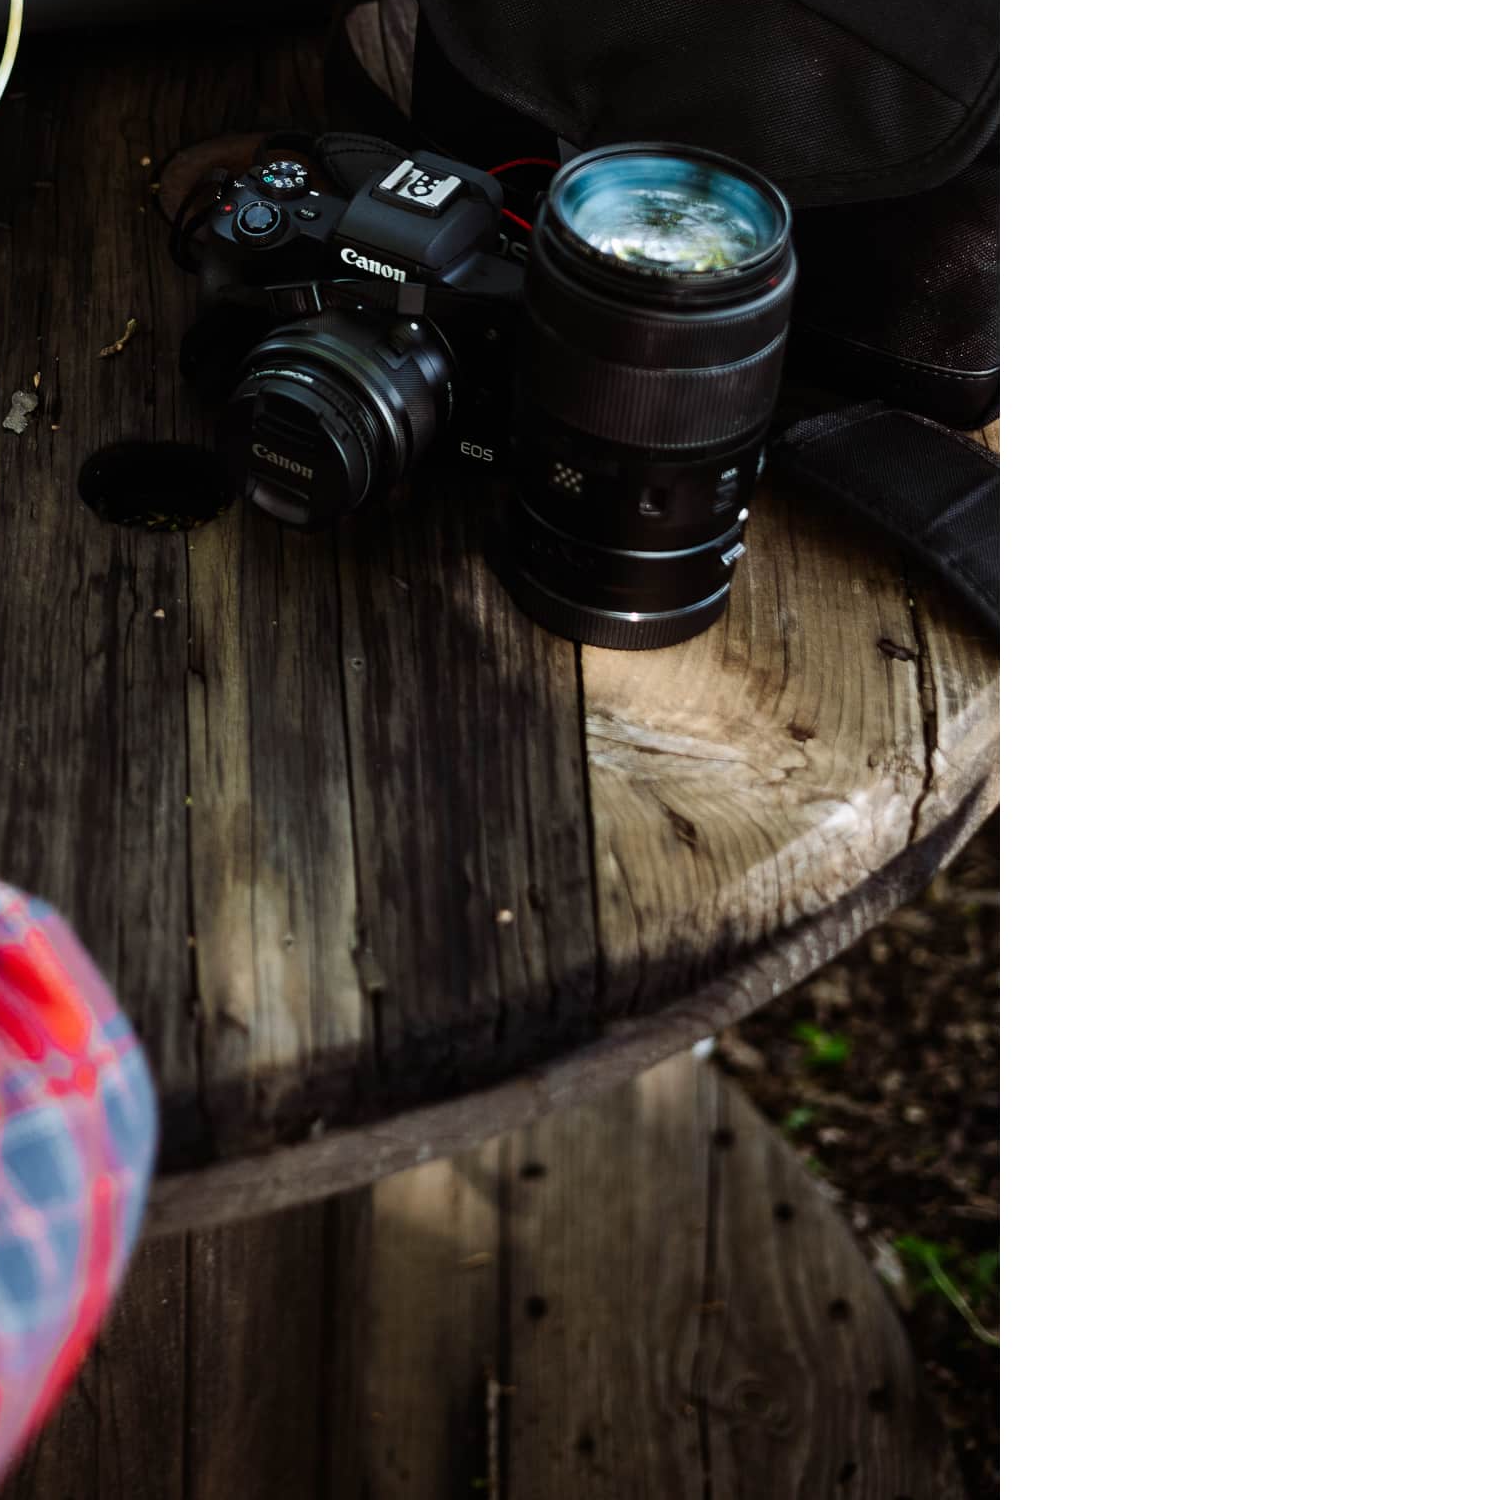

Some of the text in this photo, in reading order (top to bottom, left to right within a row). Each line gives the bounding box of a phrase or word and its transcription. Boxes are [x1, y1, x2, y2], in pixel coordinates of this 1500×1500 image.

[340, 247, 406, 283] Canon
[252, 443, 315, 481] Canon
[460, 440, 494, 462] EOS
